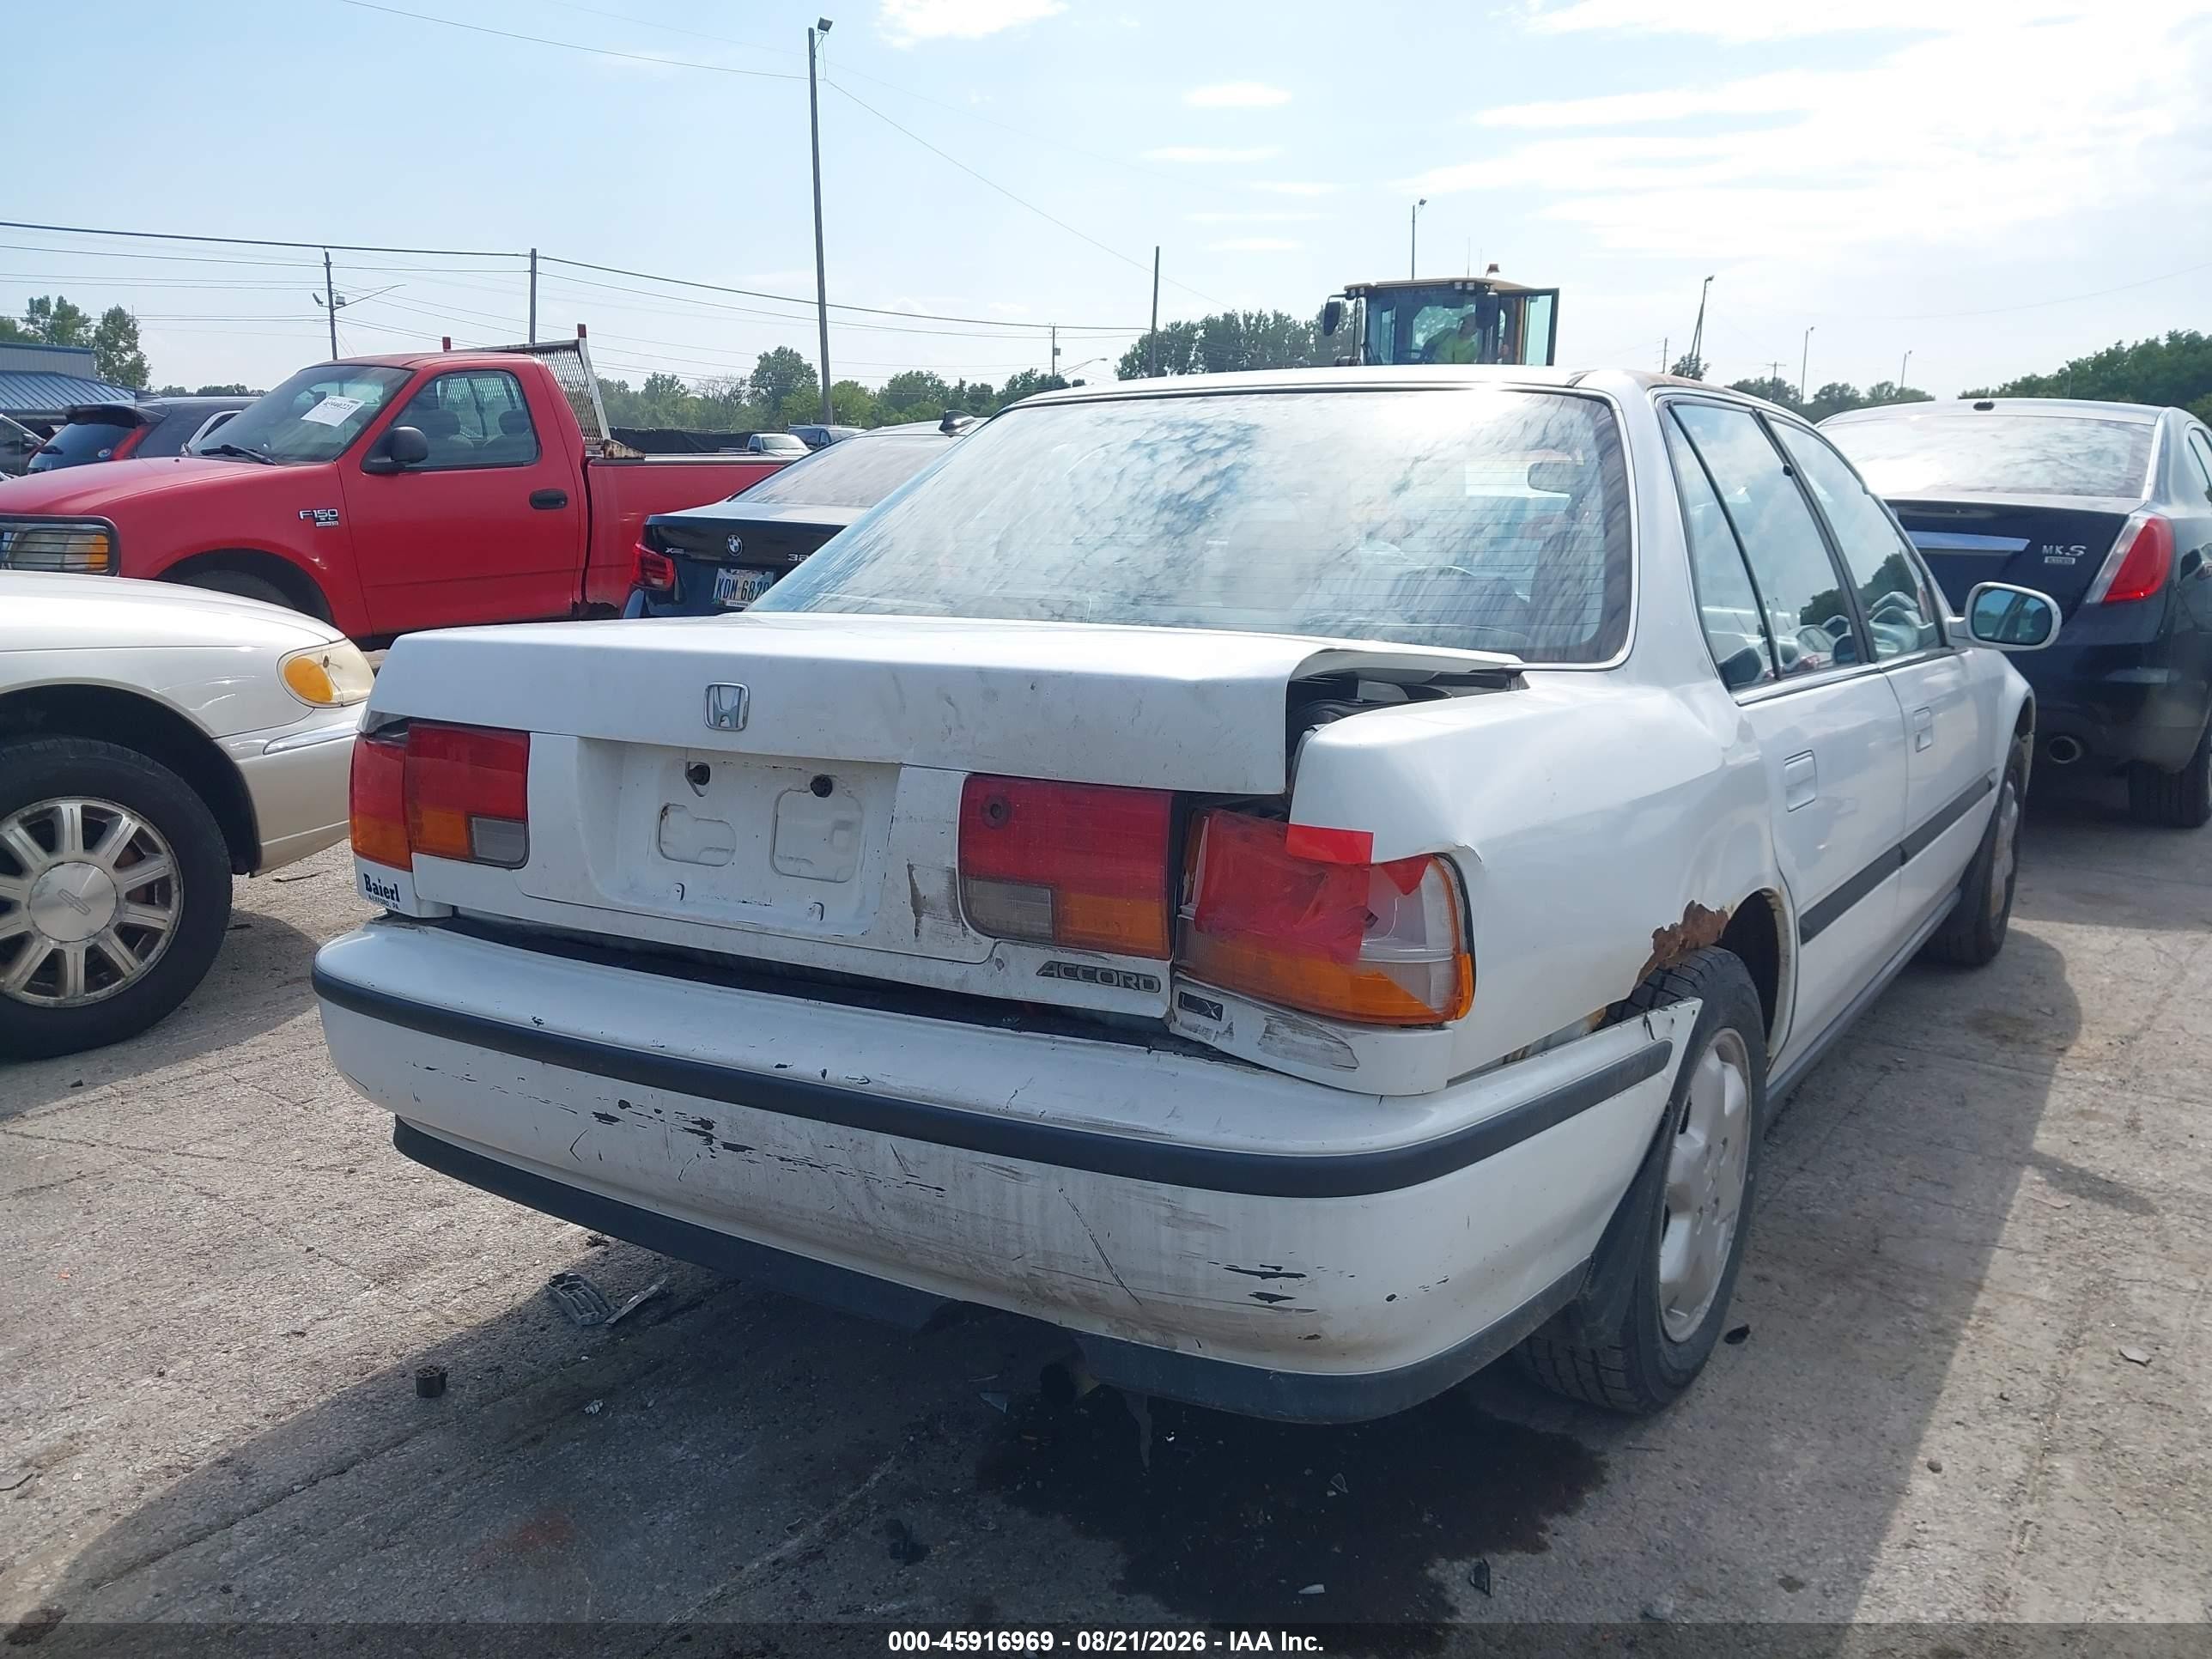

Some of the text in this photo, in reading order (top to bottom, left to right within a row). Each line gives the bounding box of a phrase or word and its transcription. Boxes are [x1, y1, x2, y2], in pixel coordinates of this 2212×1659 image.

[2042, 544, 2087, 556] MKS
[363, 872, 400, 902] Baierl
[1036, 961, 1162, 994] ACCORD
[1181, 994, 1220, 1019] LX
